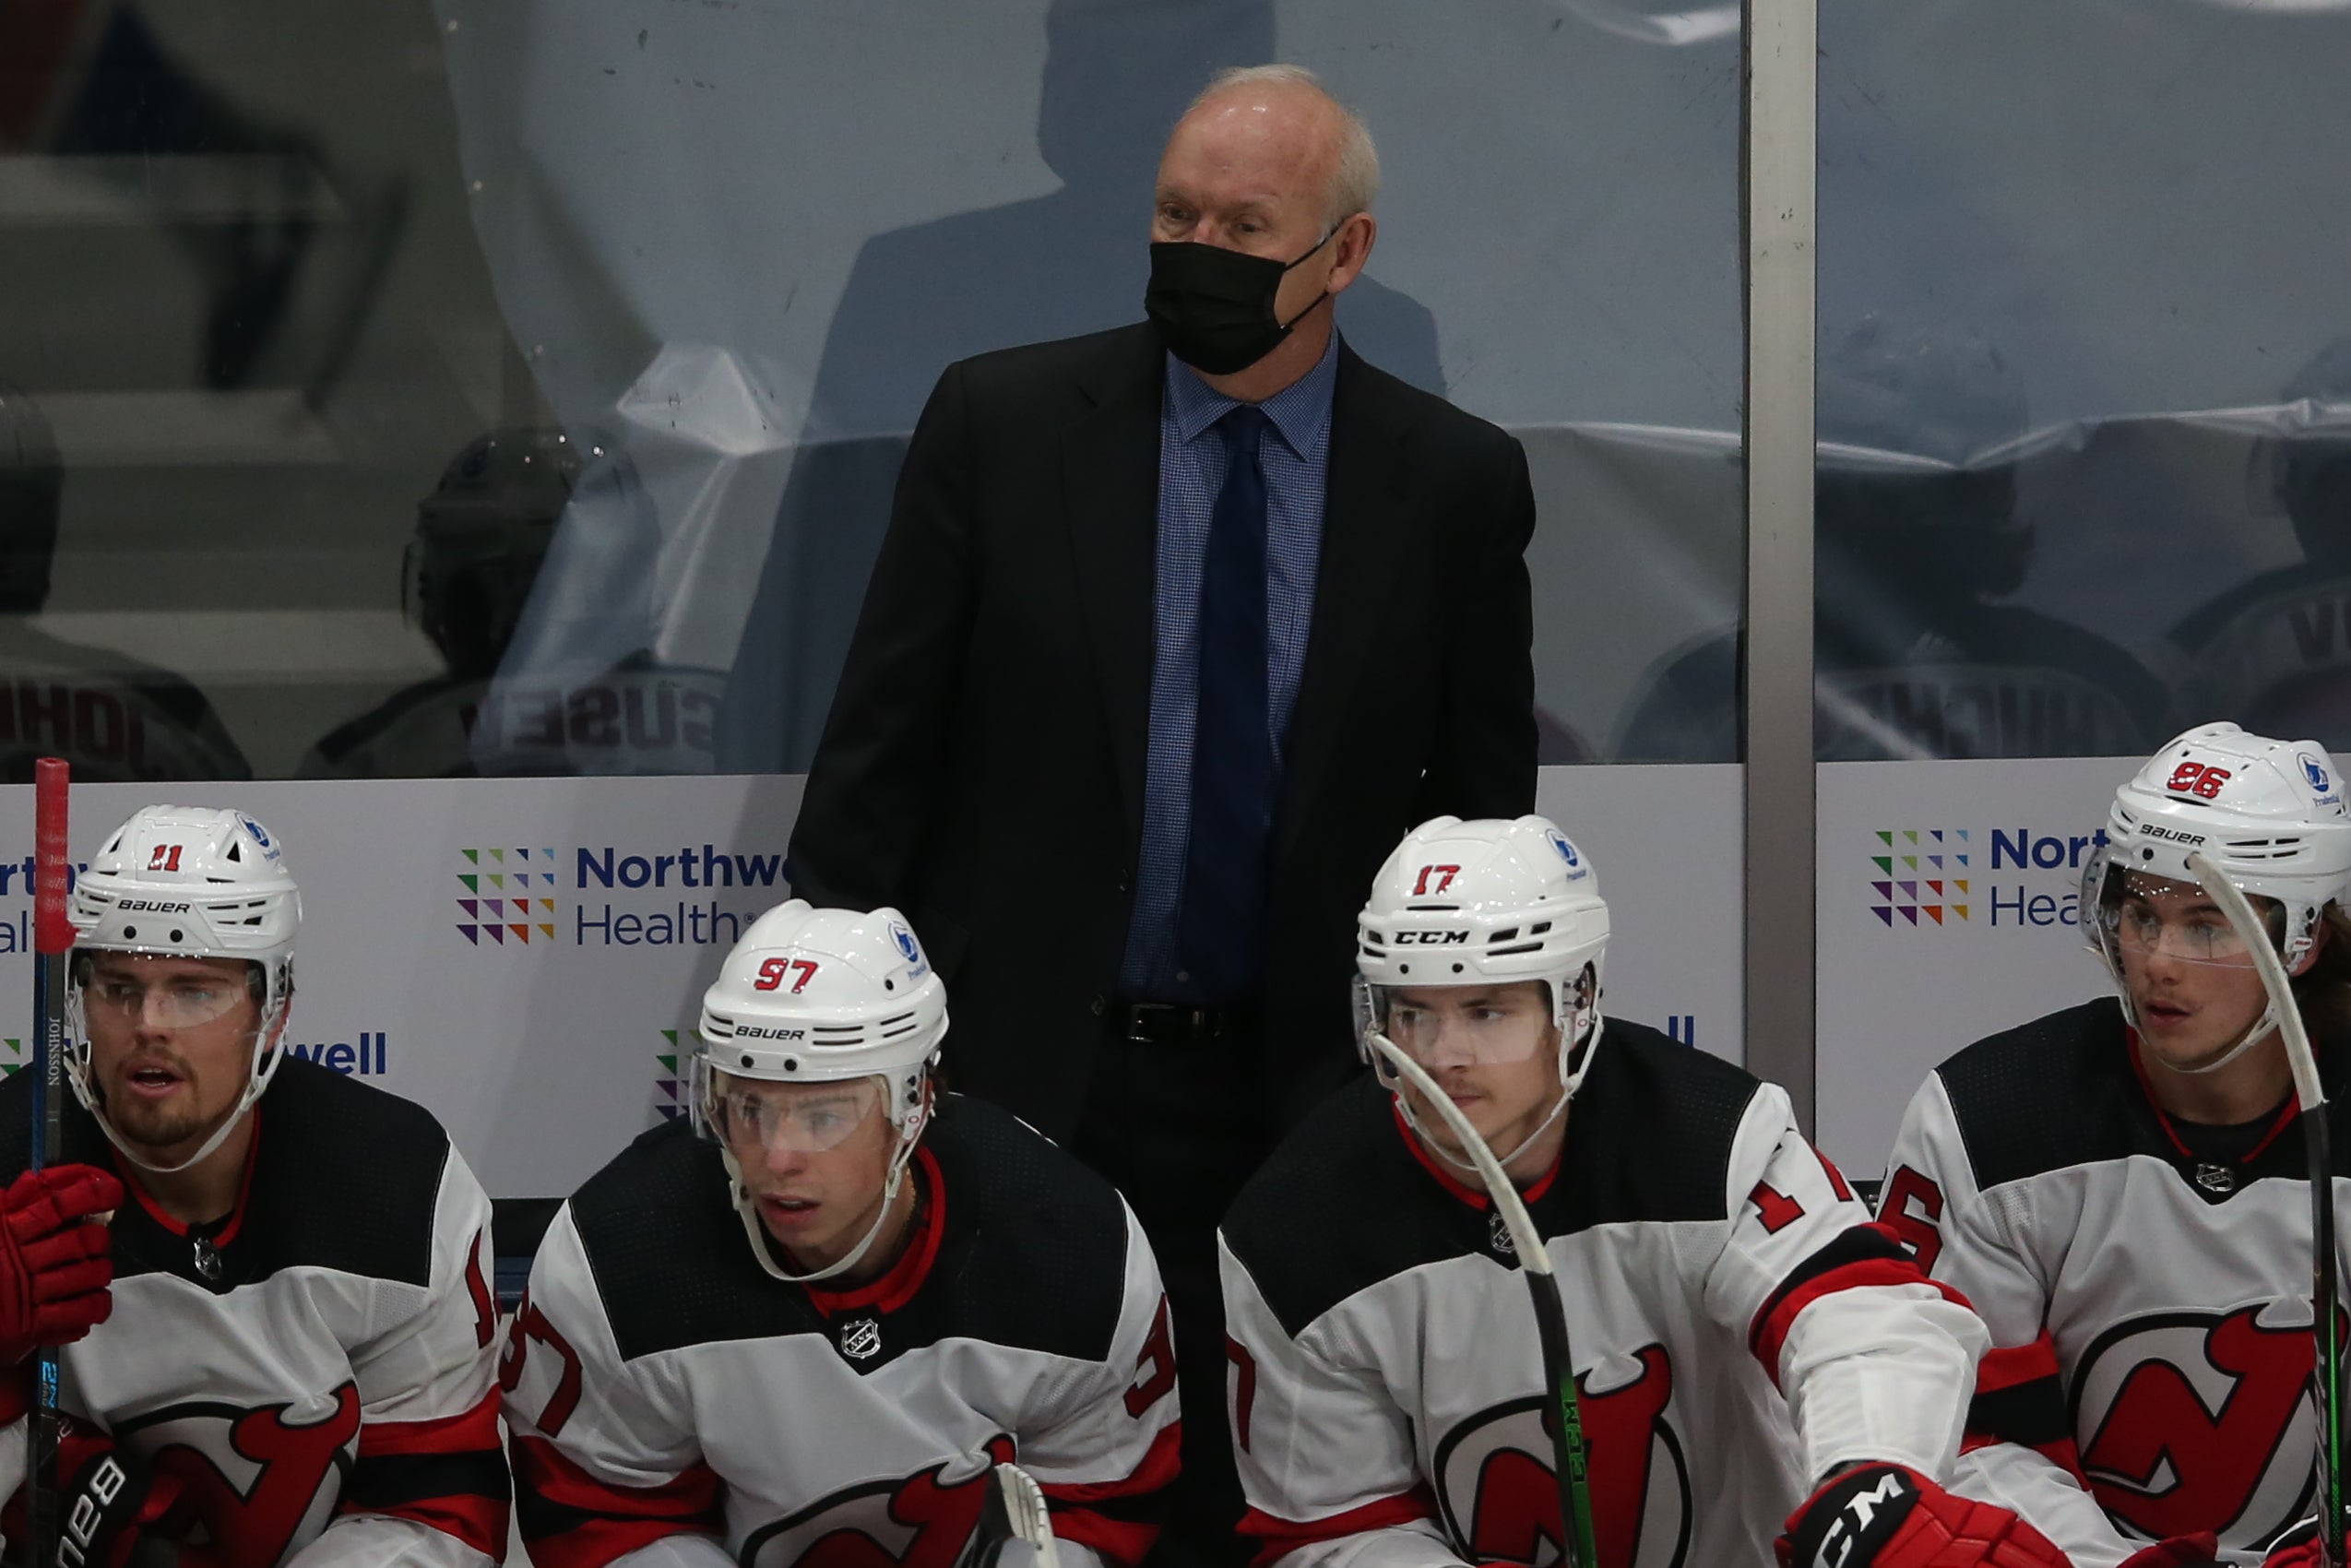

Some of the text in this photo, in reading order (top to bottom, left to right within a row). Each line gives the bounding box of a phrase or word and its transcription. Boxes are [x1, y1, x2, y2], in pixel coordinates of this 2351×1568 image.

[2167, 761, 2232, 800] 86
[148, 844, 183, 871] 11
[576, 844, 790, 888] Northw
[1412, 864, 1461, 896] 17
[1395, 930, 1470, 944] CCM
[754, 957, 818, 994] 97
[48, 1016, 61, 1086] JOHNSSON
[1563, 1400, 1586, 1483] CCM
